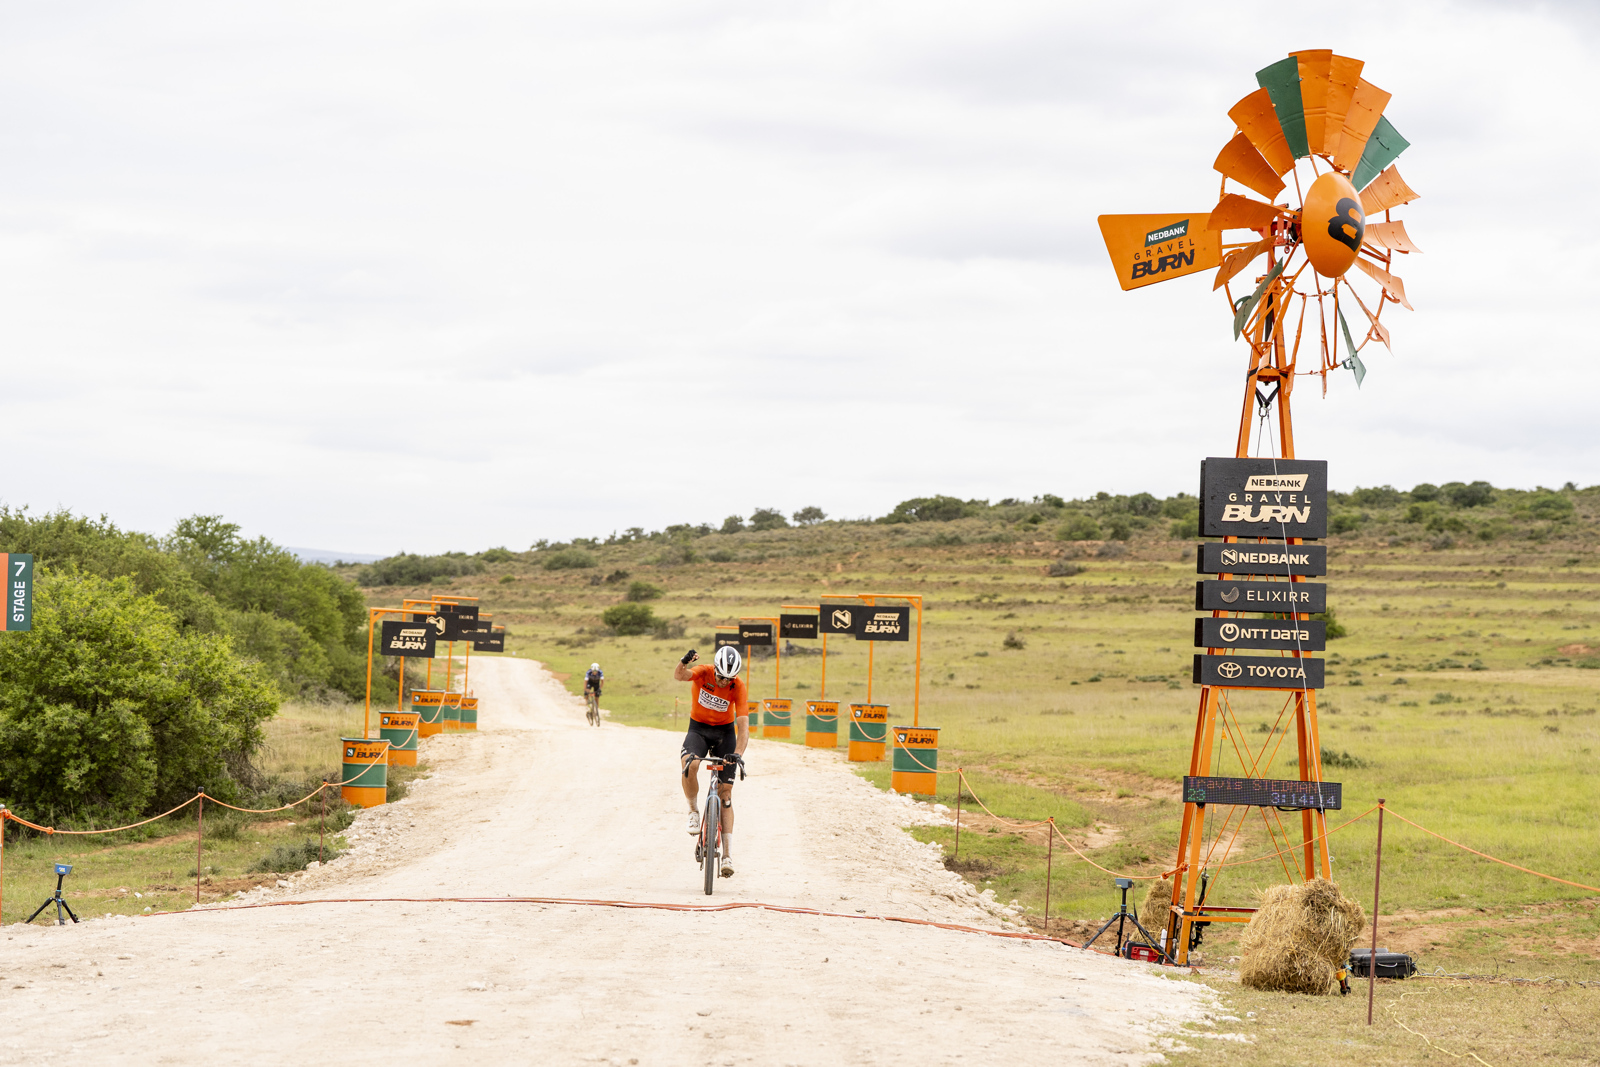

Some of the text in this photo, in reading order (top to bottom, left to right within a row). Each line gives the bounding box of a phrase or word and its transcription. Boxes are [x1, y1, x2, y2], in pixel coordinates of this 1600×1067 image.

[1147, 225, 1186, 242] NEDBANK
[1133, 238, 1195, 260] GRAVEL
[1131, 249, 1195, 280] BURN
[1251, 478, 1301, 488] NEDBANK
[1228, 492, 1312, 504] GRAVEL
[1221, 504, 1311, 524] BURN
[1238, 552, 1310, 565] NEDBANK
[13, 561, 26, 622] STAGE 7
[1246, 590, 1310, 603] ELIXIRR
[864, 625, 900, 634] BURN
[1240, 628, 1269, 640] NTT
[390, 640, 427, 650] BURN
[1247, 665, 1307, 679] TOYOTA
[701, 689, 729, 706] TOYOTA
[355, 751, 384, 759] BURN
[1187, 776, 1318, 794] Travis STEDMAN
[1187, 788, 1206, 801] 23
